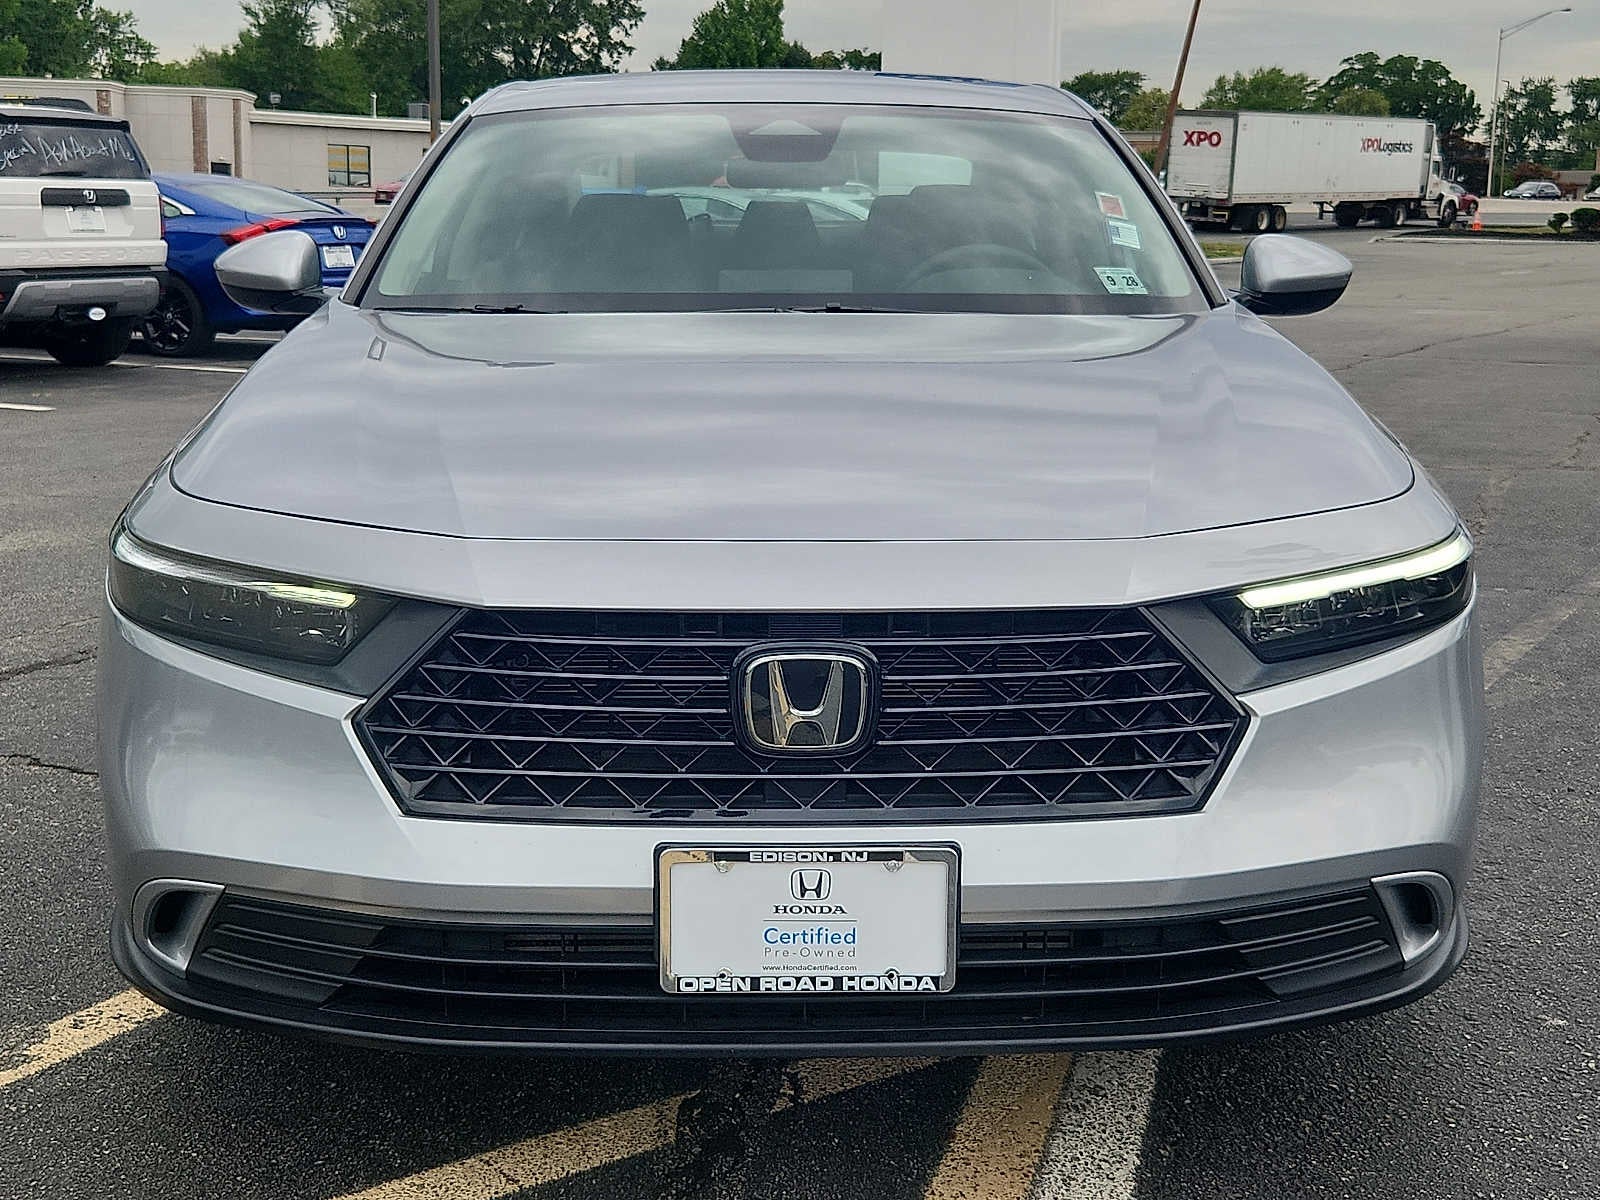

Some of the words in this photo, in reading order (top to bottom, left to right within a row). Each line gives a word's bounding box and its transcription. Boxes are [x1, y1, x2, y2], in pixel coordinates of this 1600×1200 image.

[1183, 130, 1222, 147] XPO
[15, 248, 156, 263] PASSPORT
[1106, 275, 1116, 286] 9
[1121, 275, 1139, 287] 28
[842, 852, 868, 862] NJ
[773, 905, 847, 915] HONDA
[763, 927, 857, 945] Certified
[764, 947, 856, 958] Pre-Owned
[680, 977, 750, 992] OPEN
[760, 977, 834, 992] ROAD
[843, 976, 936, 992] HONDA
